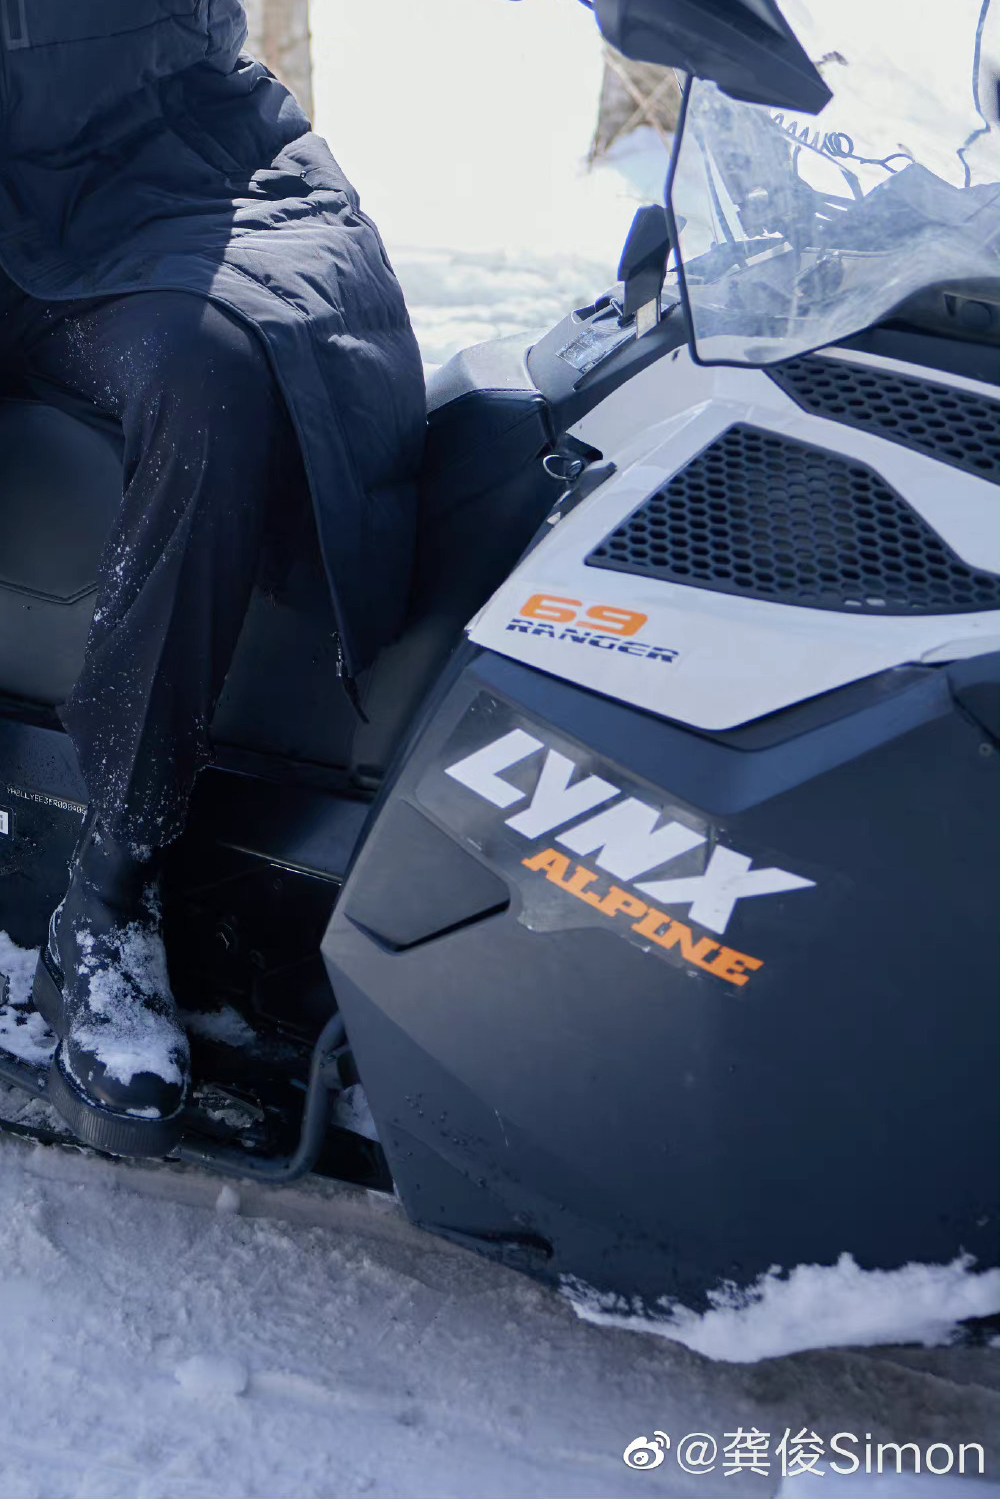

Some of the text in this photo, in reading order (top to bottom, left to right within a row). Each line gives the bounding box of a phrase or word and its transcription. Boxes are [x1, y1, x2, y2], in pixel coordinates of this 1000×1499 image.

[505, 618, 679, 663] RANGER
[520, 594, 648, 636] 69
[444, 728, 817, 935] LYNX
[521, 848, 764, 987] ALPINE
